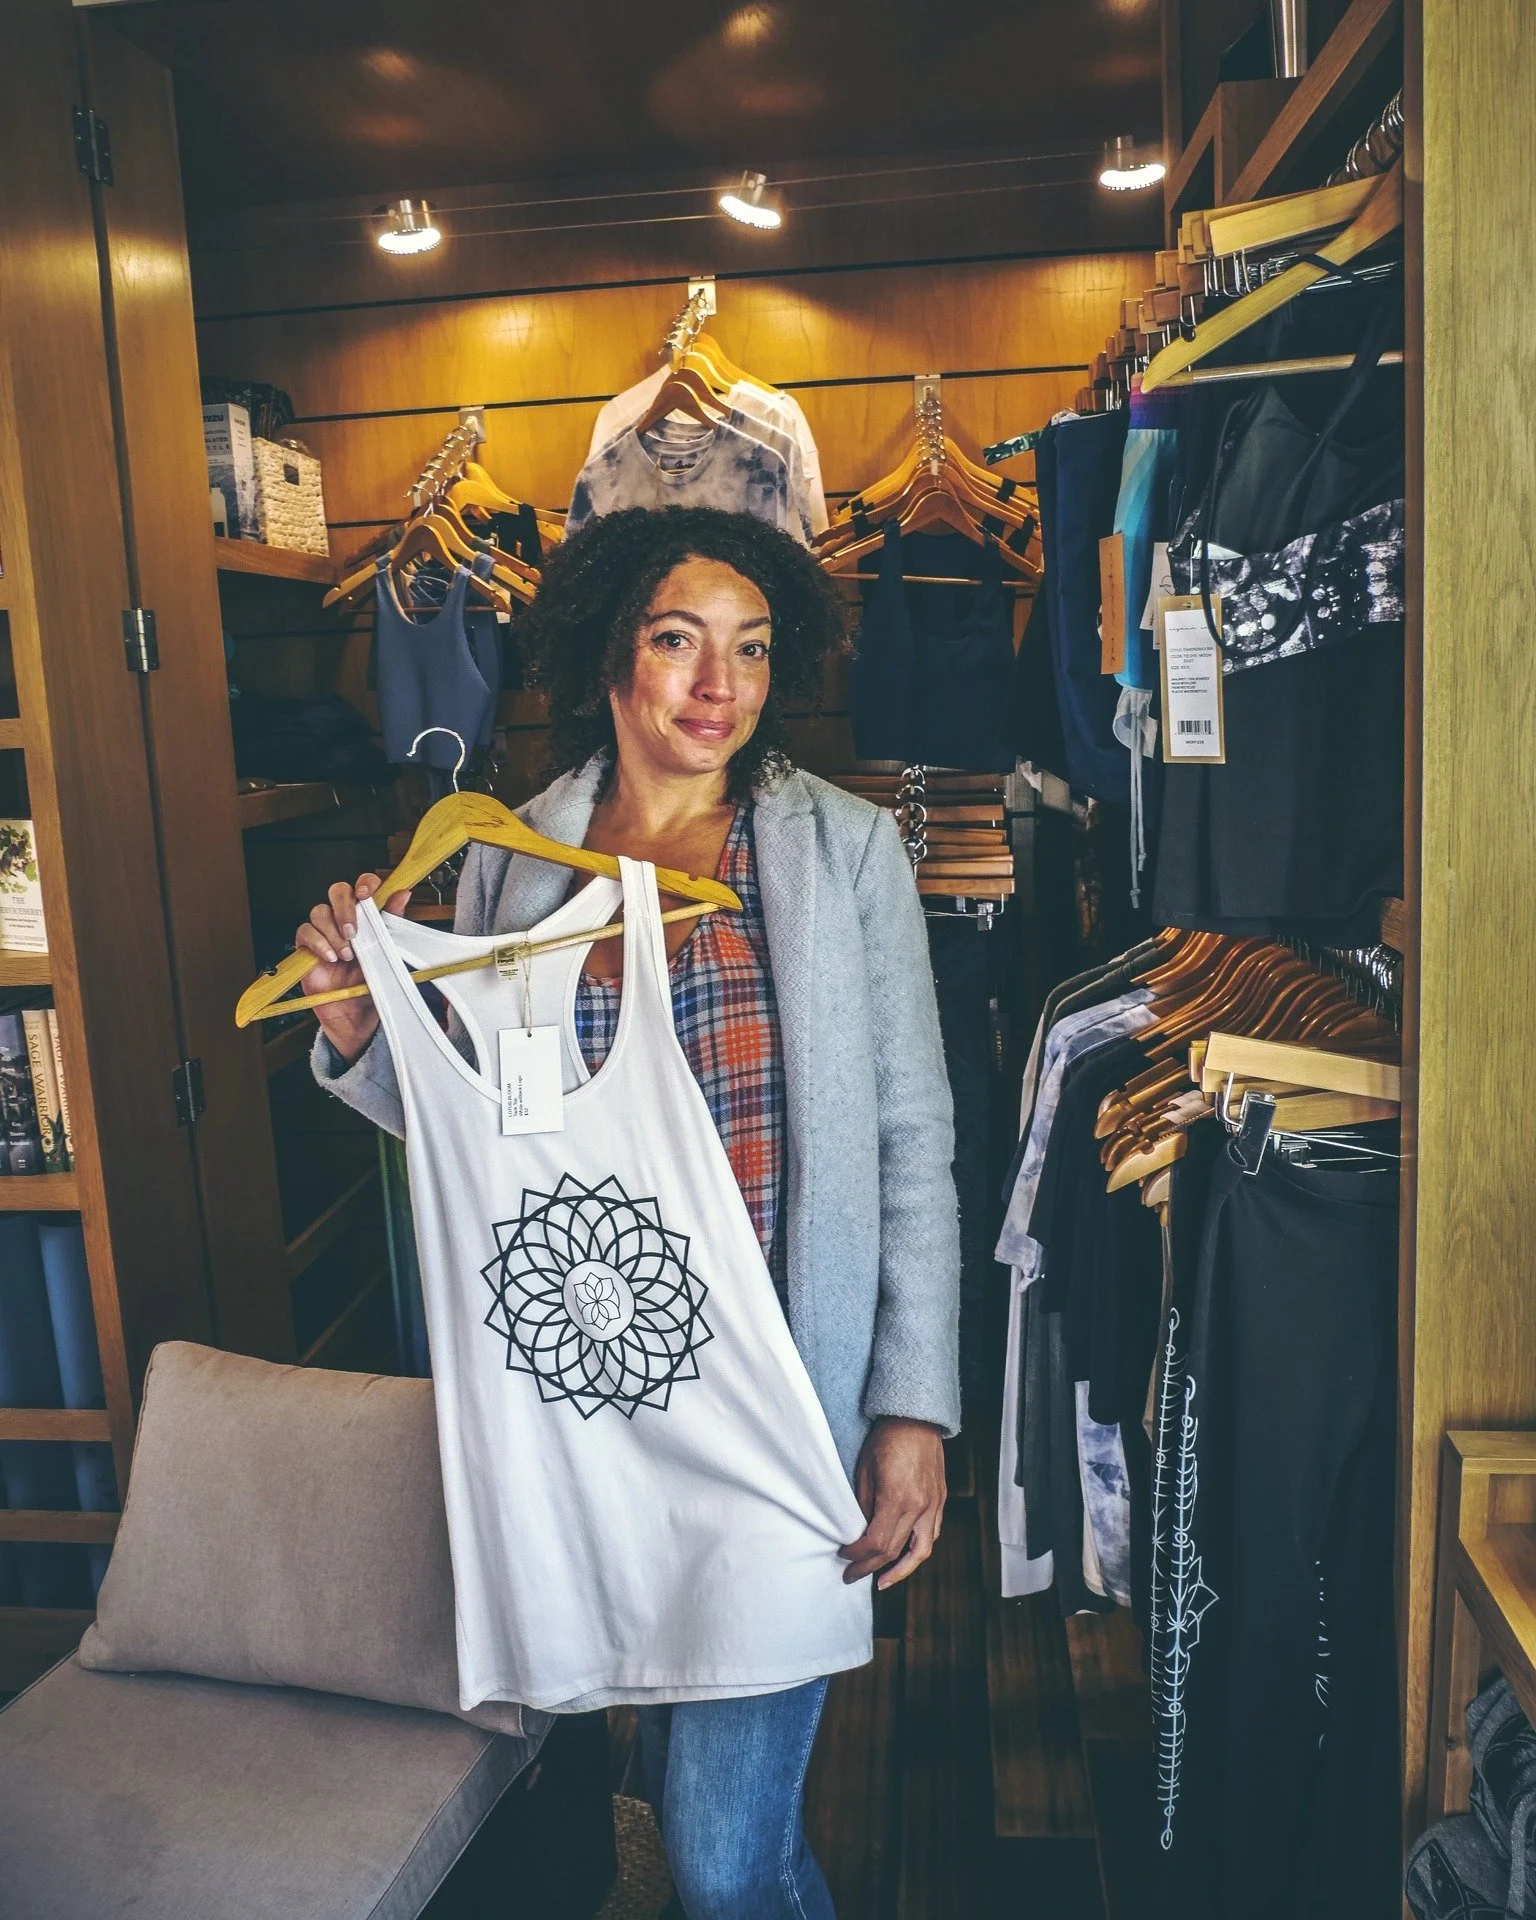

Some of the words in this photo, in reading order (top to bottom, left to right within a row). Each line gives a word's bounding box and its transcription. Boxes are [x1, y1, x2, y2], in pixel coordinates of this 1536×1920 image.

[0, 907, 44, 916] ERVICEBERRY
[28, 1033, 42, 1068] SAGE
[34, 1073, 52, 1138] WARRIOR
